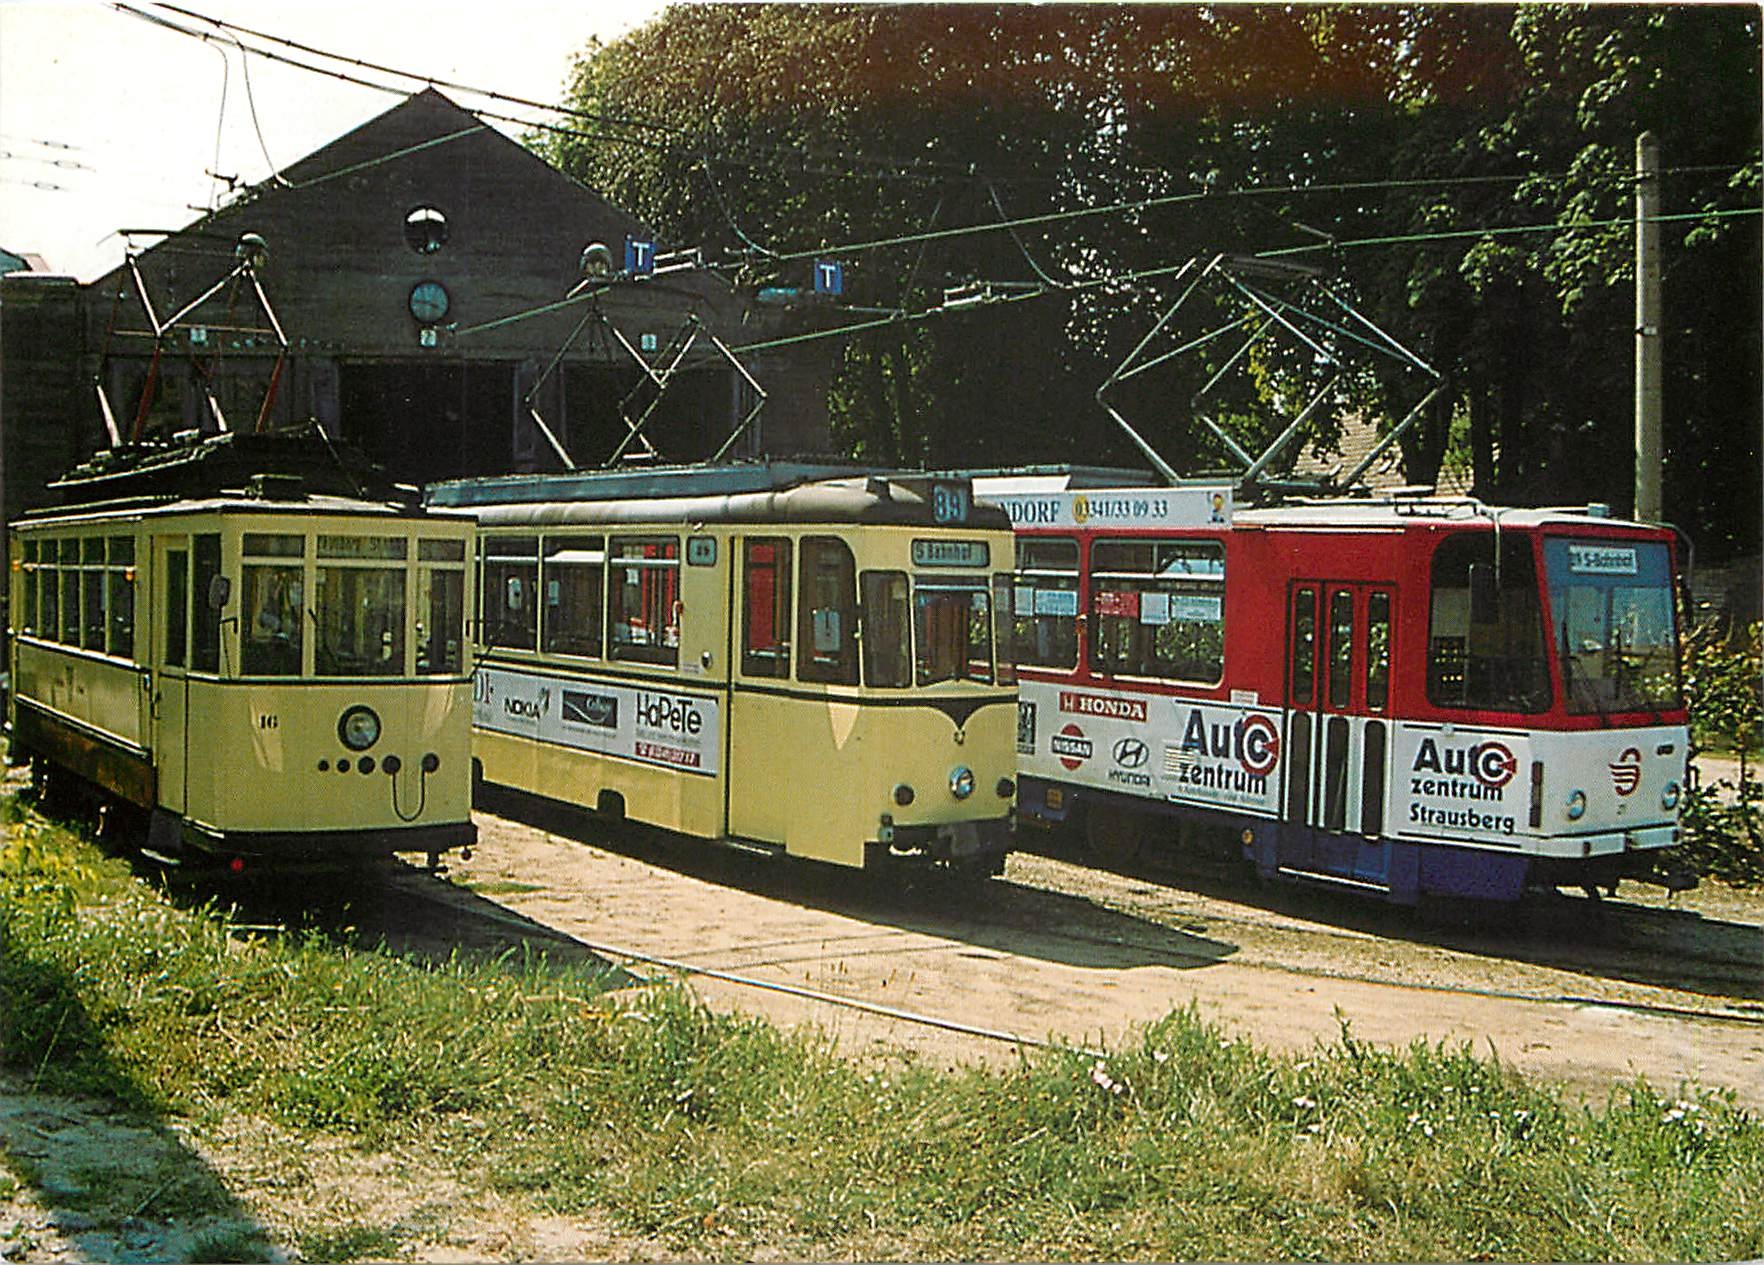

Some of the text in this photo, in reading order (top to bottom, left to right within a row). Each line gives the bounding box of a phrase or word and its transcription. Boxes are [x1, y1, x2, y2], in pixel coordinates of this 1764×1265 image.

[1151, 500, 1168, 518] 33
[504, 698, 541, 720] NOKIA
[636, 693, 702, 734] HaPeTe
[1080, 697, 1144, 719] HONDA
[261, 715, 278, 729] 16
[1053, 738, 1091, 757] NISSAN
[1179, 763, 1267, 796] zentrum
[1411, 778, 1503, 801] zentrum
[1410, 802, 1515, 836] Strausberg
